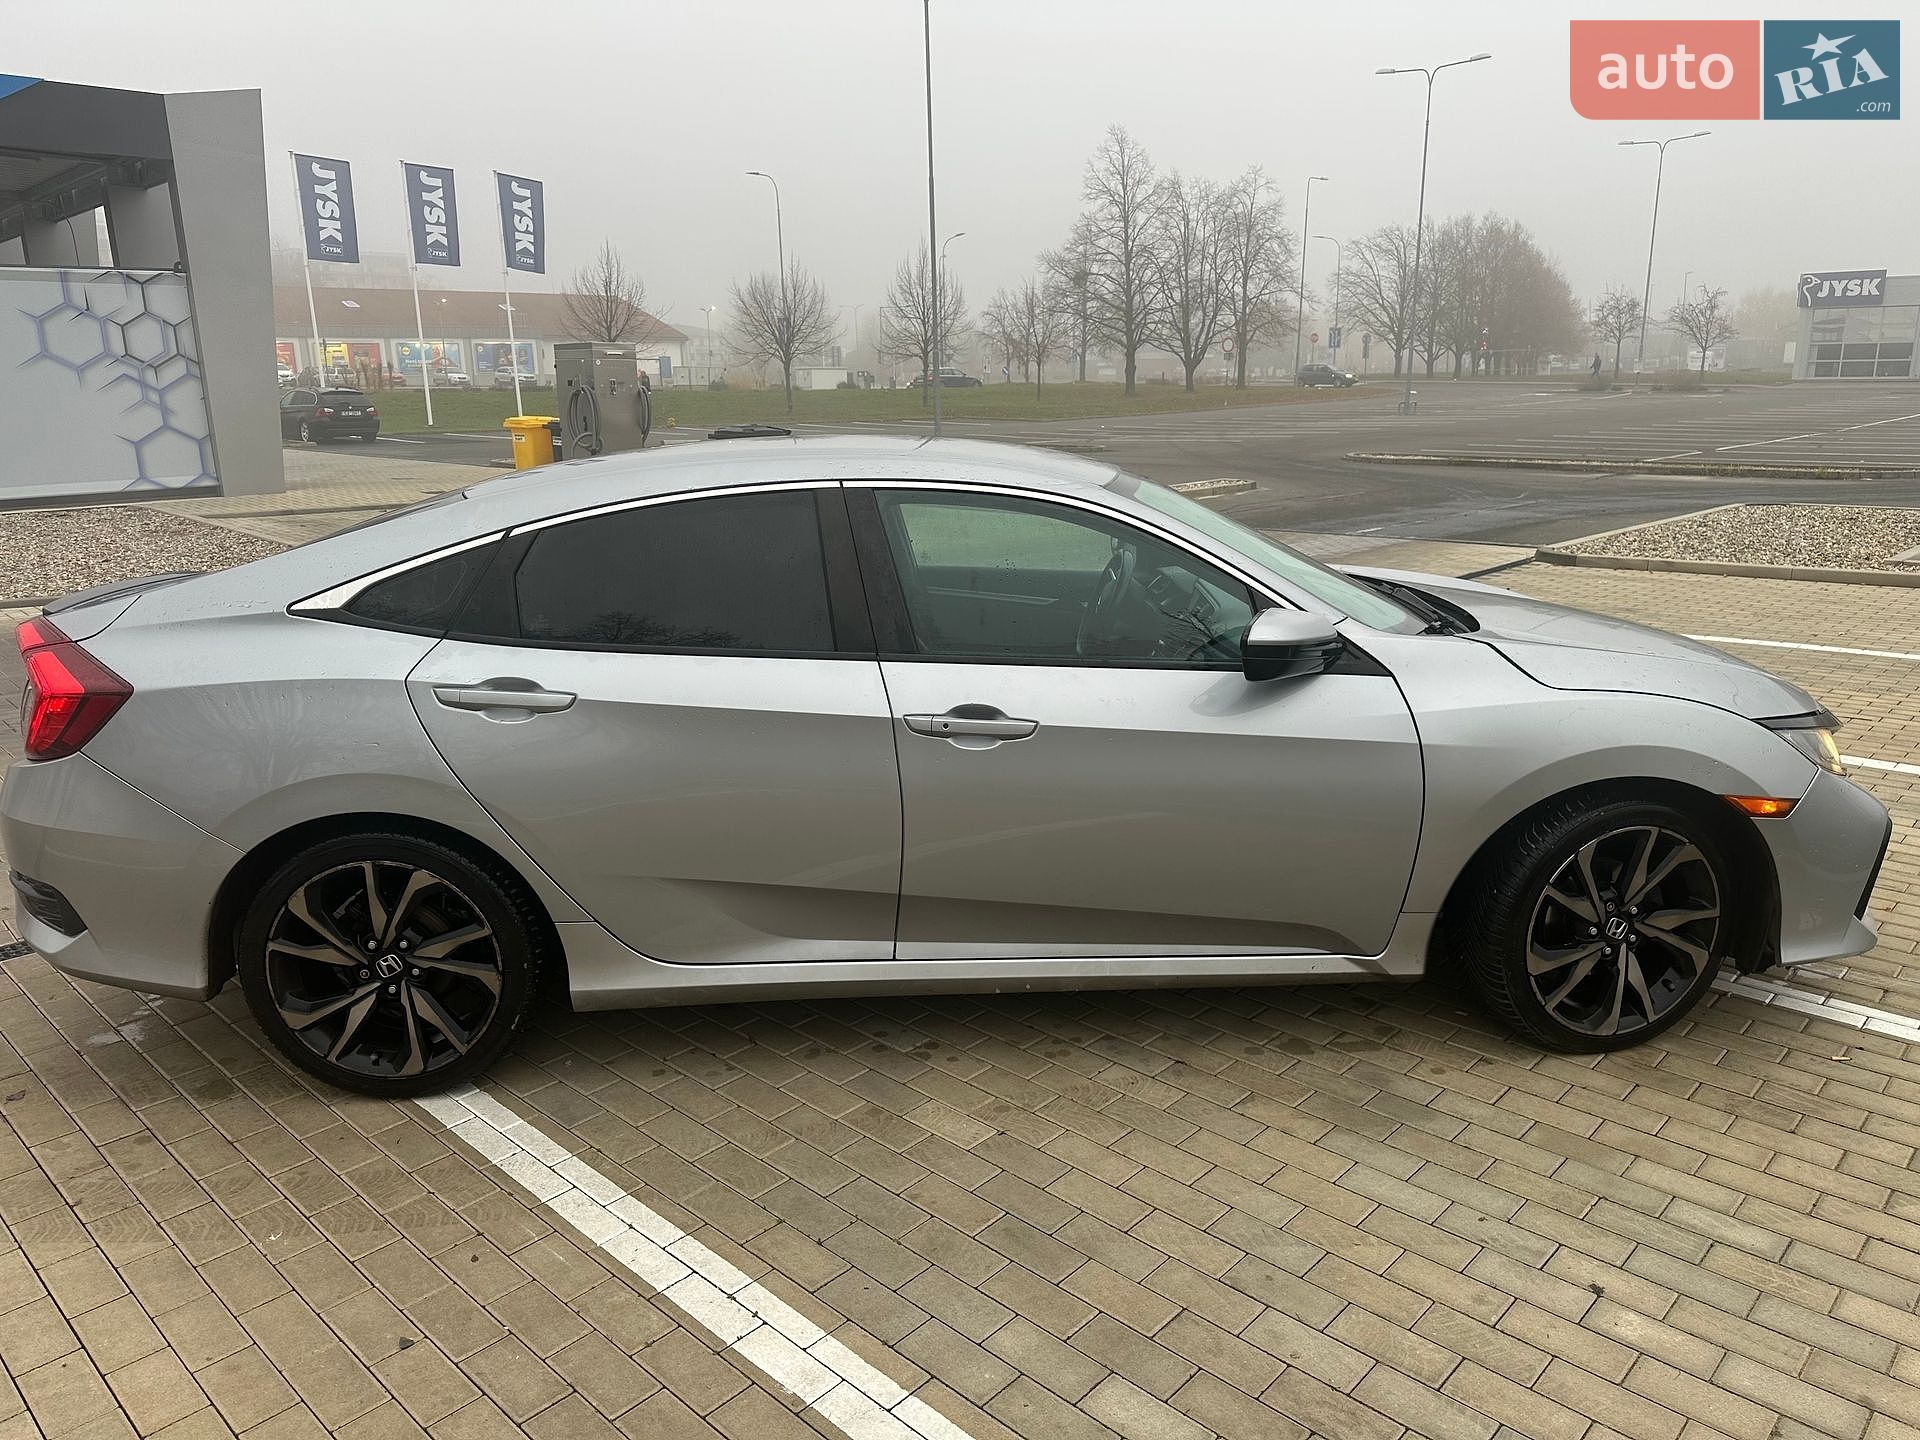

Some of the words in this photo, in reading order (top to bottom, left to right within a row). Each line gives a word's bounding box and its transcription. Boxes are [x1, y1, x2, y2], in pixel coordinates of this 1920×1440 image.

[311, 161, 343, 243] JYSK
[419, 170, 448, 246] JYSK
[510, 180, 535, 254] JYSK
[1816, 278, 1881, 298] JYSK
